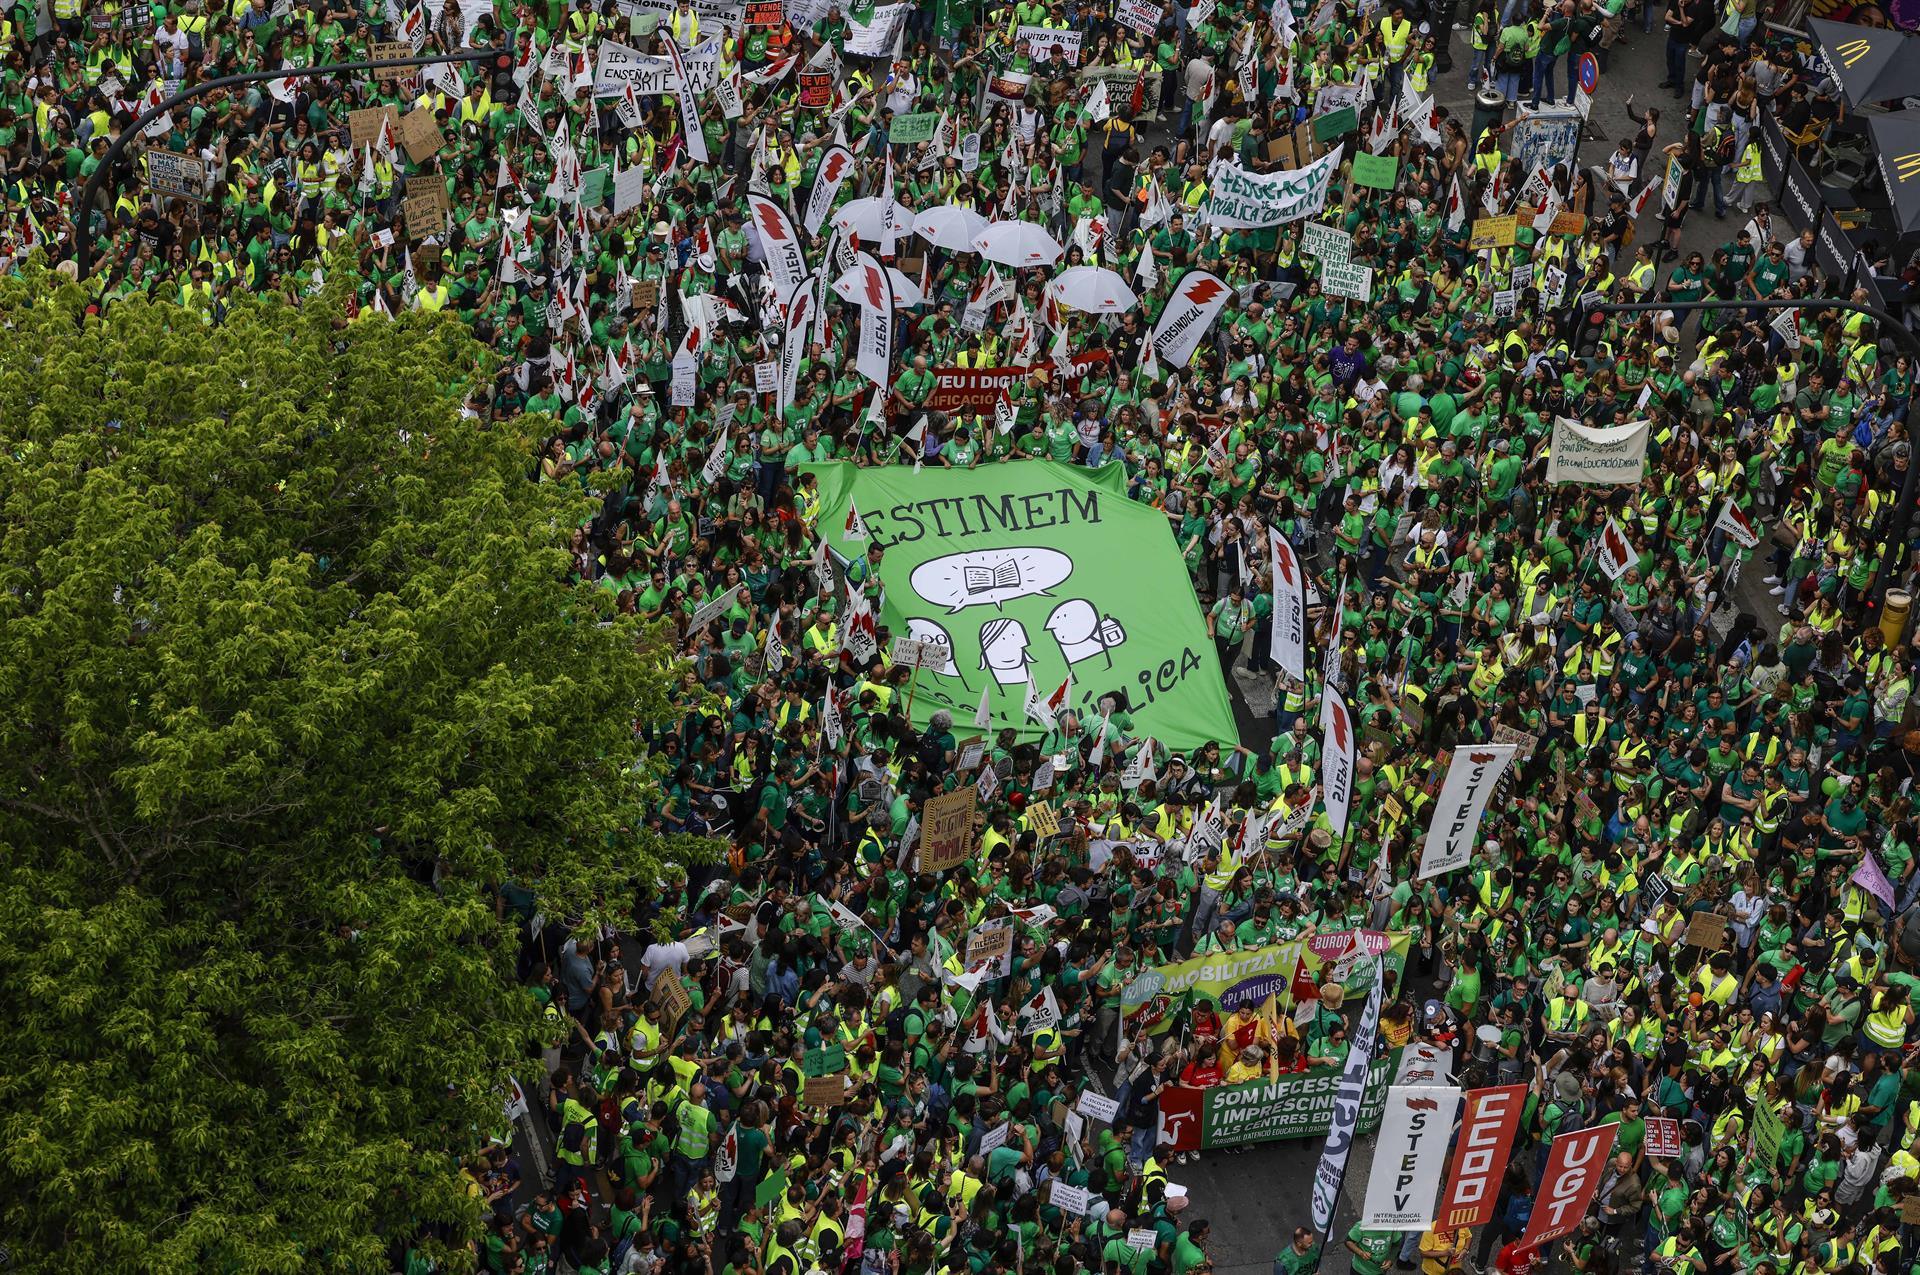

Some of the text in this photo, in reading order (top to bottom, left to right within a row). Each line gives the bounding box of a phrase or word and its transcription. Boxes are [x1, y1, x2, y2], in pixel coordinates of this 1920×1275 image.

[747, 2, 782, 12] SE VENDE
[607, 51, 628, 64] IES
[684, 61, 715, 72] NTRE
[800, 76, 812, 86] SE
[1787, 174, 1815, 223] McDonald's
[1305, 226, 1350, 245] QUALITAT
[1303, 236, 1349, 256] LLUITAREM
[1314, 246, 1348, 263] VERITAT
[1819, 225, 1849, 275] McDonald's
[1325, 269, 1364, 283] BARRACONS
[1327, 278, 1360, 290] DEMANEM
[1153, 305, 1204, 352] NTERSINDICAL
[1583, 456, 1619, 469] EDUCACIÓ
[860, 488, 1103, 551] ESTIMEM
[1445, 766, 1487, 856] STEPV
[1167, 943, 1302, 993] MOBILITZA'T!
[1212, 1087, 1261, 1110] SOM
[1211, 1112, 1220, 1126] I
[1211, 1125, 1242, 1138] ALS
[1244, 1113, 1309, 1136] CENTRES
[1453, 1092, 1511, 1205] CCOO
[1394, 1112, 1428, 1213] STEPV
[1549, 1134, 1600, 1227] UGT
[1373, 1212, 1422, 1220] INTERSINDICAL
[1380, 1217, 1422, 1225] VALENCIANA
